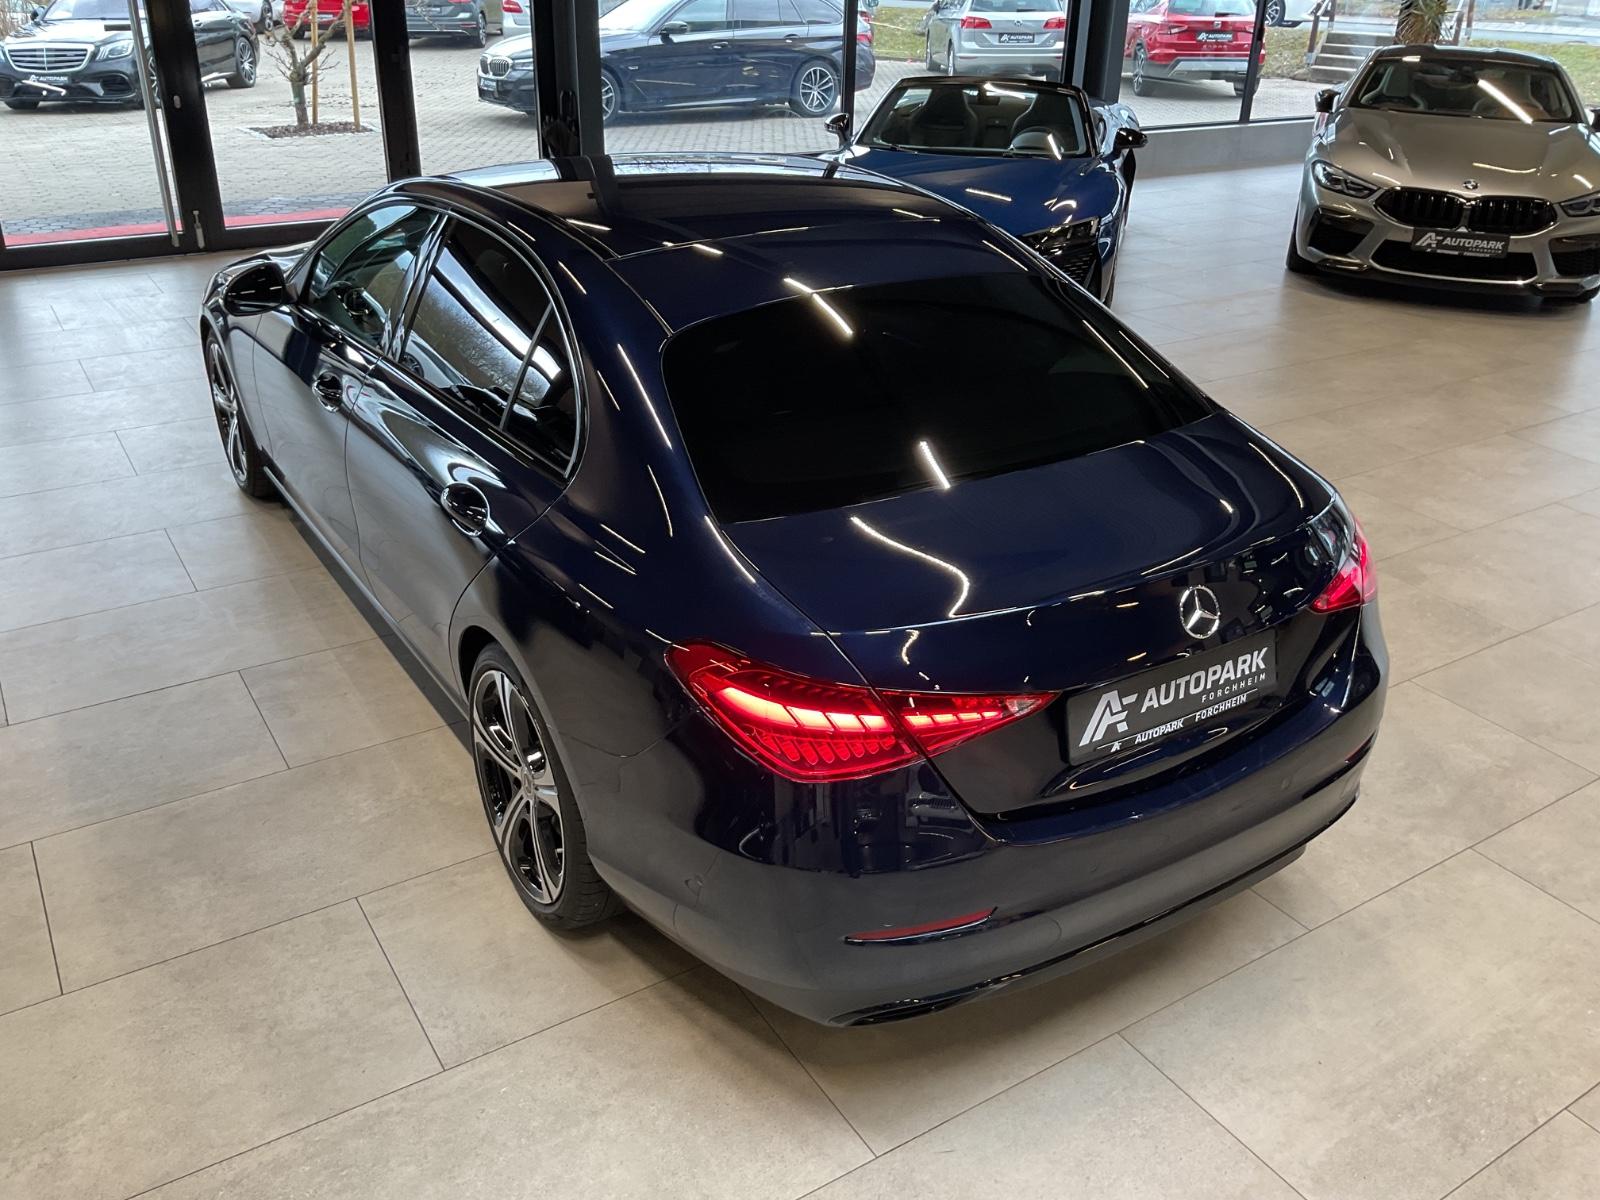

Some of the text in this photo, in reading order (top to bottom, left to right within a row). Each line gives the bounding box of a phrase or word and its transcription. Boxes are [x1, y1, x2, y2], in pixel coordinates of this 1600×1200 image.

[1442, 237, 1505, 249] AUTOPARK
[1140, 647, 1268, 713] AUTOPARK
[1202, 672, 1267, 703] FORCHHEIM
[1134, 694, 1247, 745] AUTOPARK FORCHHEIM
